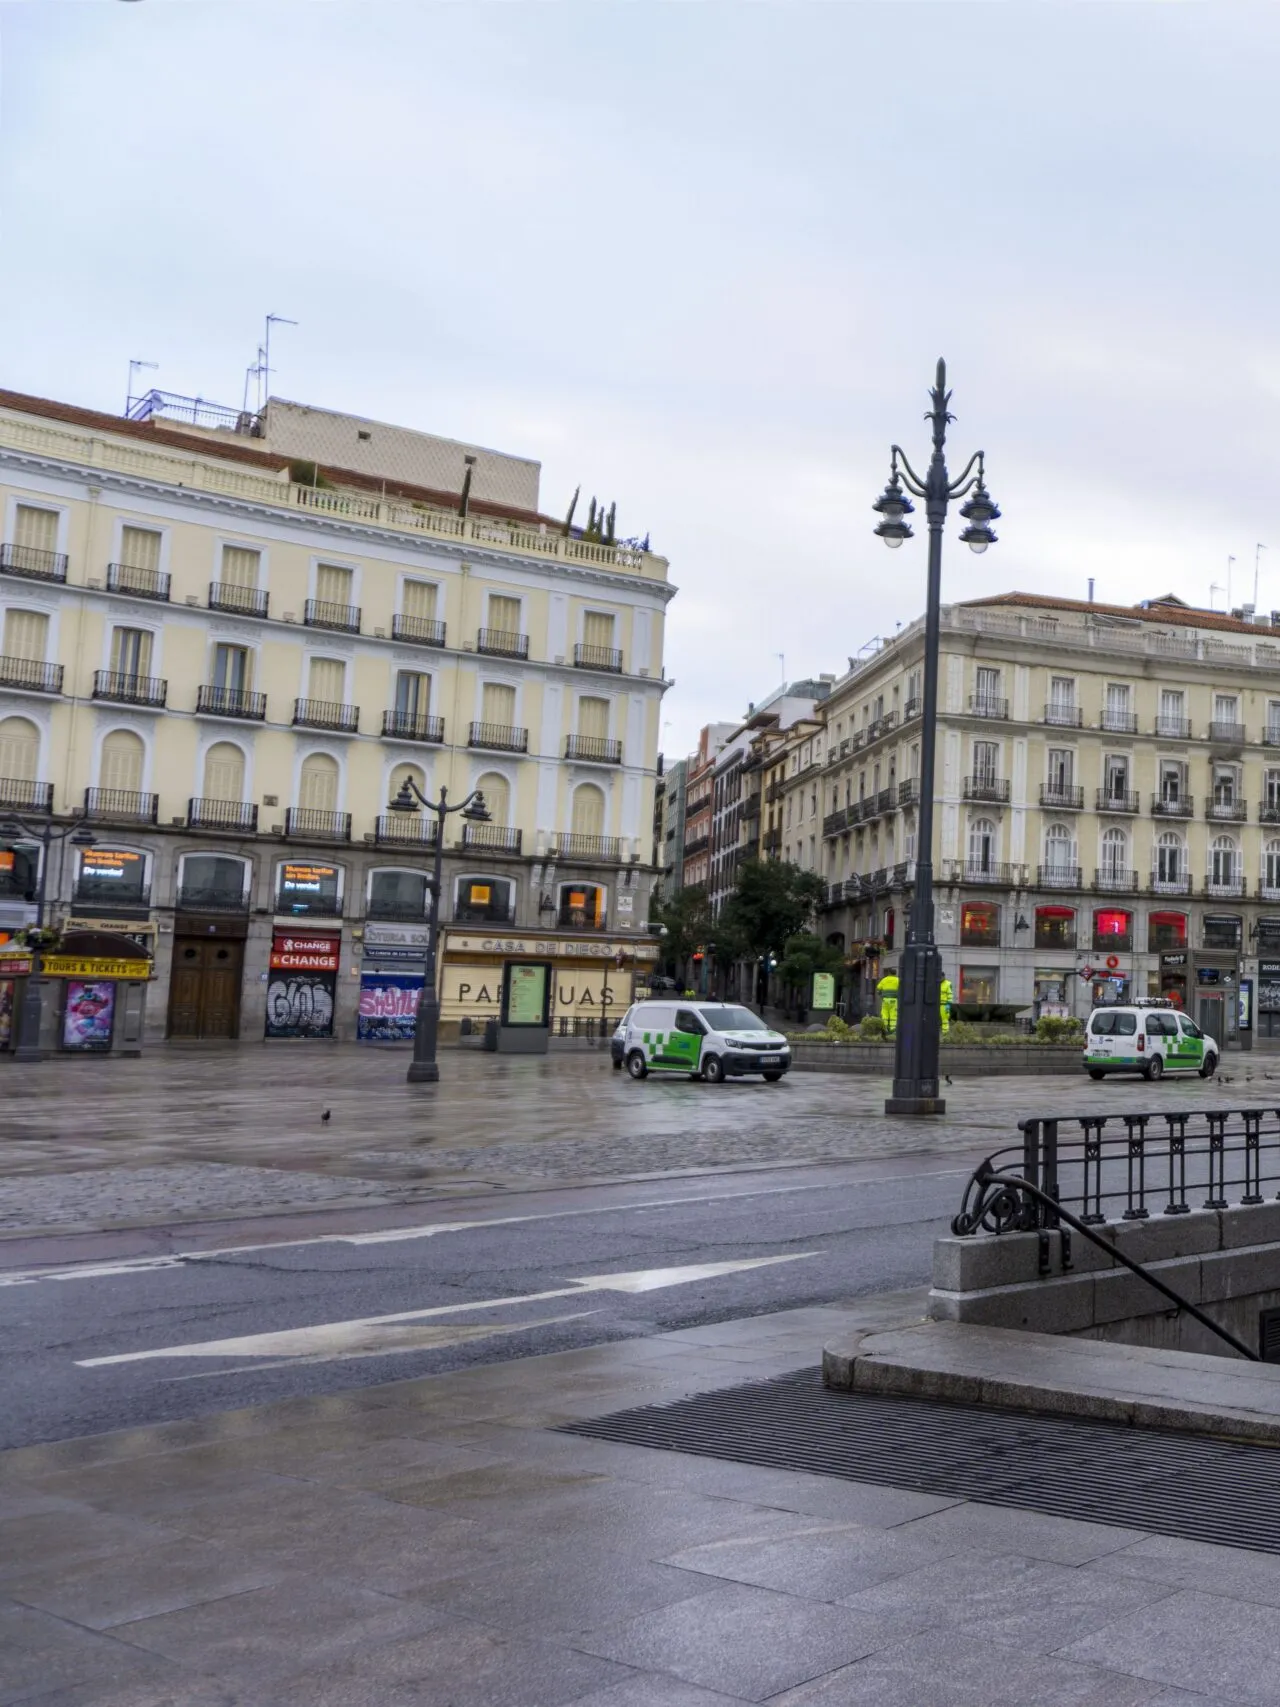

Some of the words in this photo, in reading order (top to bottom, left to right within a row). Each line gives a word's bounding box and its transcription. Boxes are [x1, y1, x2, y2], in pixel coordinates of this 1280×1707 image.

[294, 941, 331, 950] CHANGE
[481, 939, 525, 952] CASA
[535, 942, 556, 953] DE
[565, 943, 612, 956] DIEGO
[281, 954, 336, 966] CHANGE
[48, 961, 77, 972] TOURS
[80, 963, 86, 972] &
[90, 963, 127, 974] TICKETS
[458, 982, 614, 1006] PAUAS
